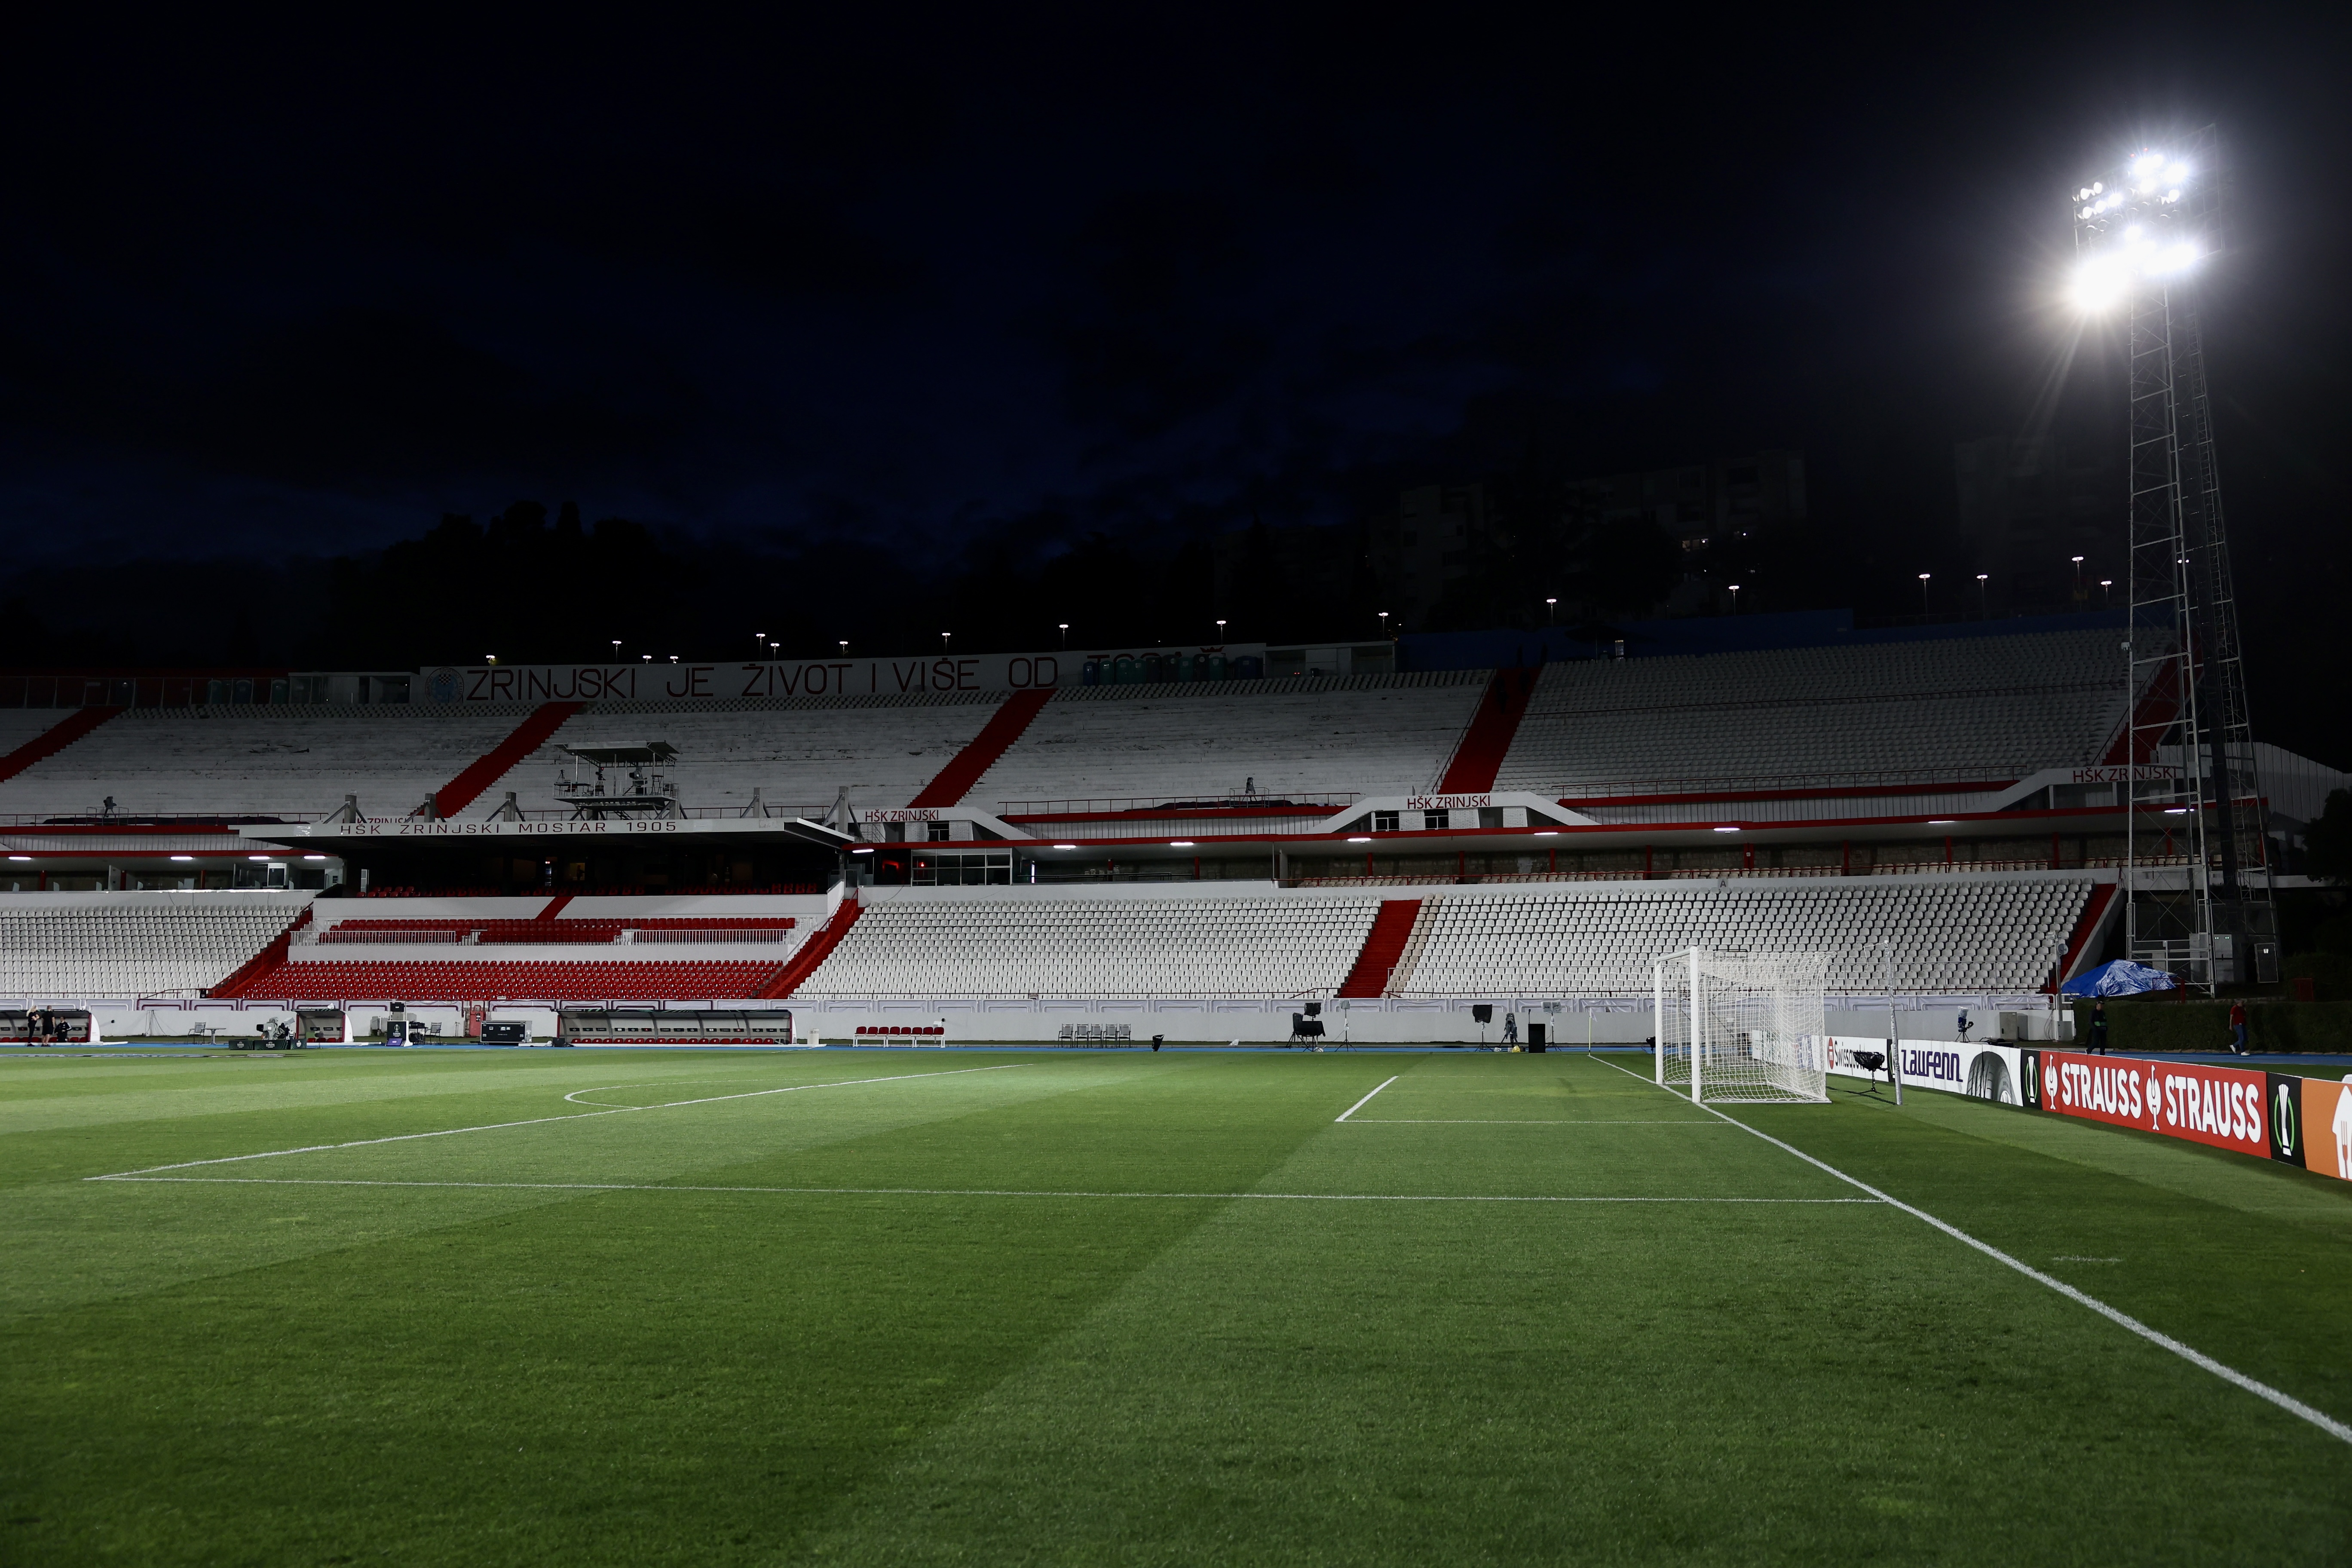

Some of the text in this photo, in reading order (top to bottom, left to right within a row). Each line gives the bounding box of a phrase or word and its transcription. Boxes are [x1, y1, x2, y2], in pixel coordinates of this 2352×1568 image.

[467, 668, 635, 701] ZRINJSKI
[666, 667, 714, 697] JE
[741, 663, 853, 697] ŽIVOT
[872, 663, 876, 693] I
[892, 657, 980, 692] VIŠE
[1008, 657, 1058, 688] OD
[2073, 766, 2177, 783] HŠK ZRNJSKI
[1407, 795, 1490, 809] HŠK ZRINJSKI
[865, 809, 939, 822] HŠK ZRINJSKI
[341, 821, 677, 834] HŠK ZRINJSKI MOSTAR 1905
[2061, 1062, 2142, 1119] STRAUSS
[2165, 1074, 2262, 1143] STRAUSS
